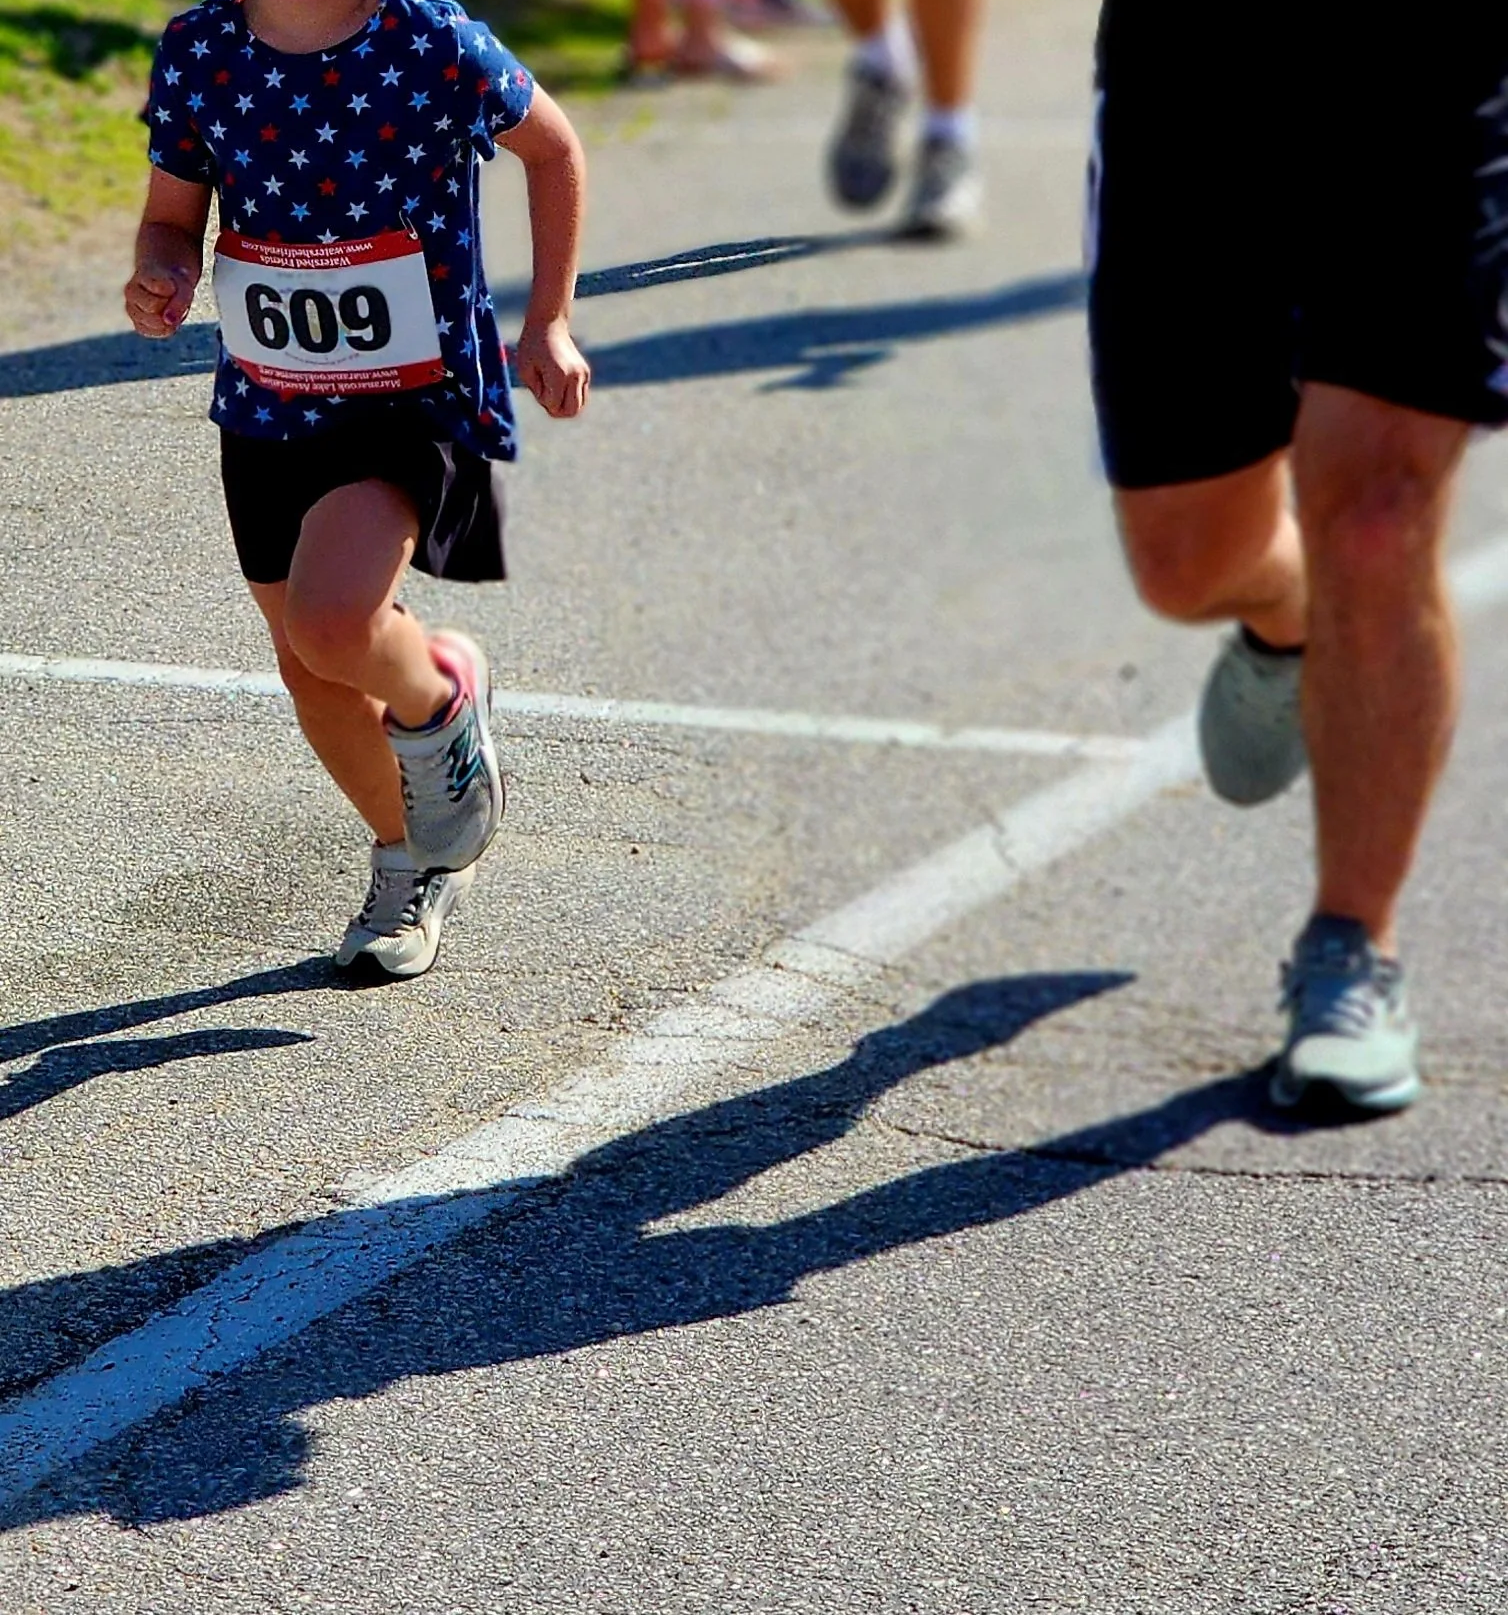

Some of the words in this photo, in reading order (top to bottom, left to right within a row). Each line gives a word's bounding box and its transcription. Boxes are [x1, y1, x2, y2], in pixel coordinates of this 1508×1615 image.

[240, 240, 373, 258] www.watershedfriends.com
[259, 254, 295, 268] Friends
[296, 255, 352, 268] Watershed
[244, 283, 392, 354] 609
[259, 375, 310, 392] Association
[311, 382, 336, 393] Lake
[337, 378, 401, 393] Maranacook
